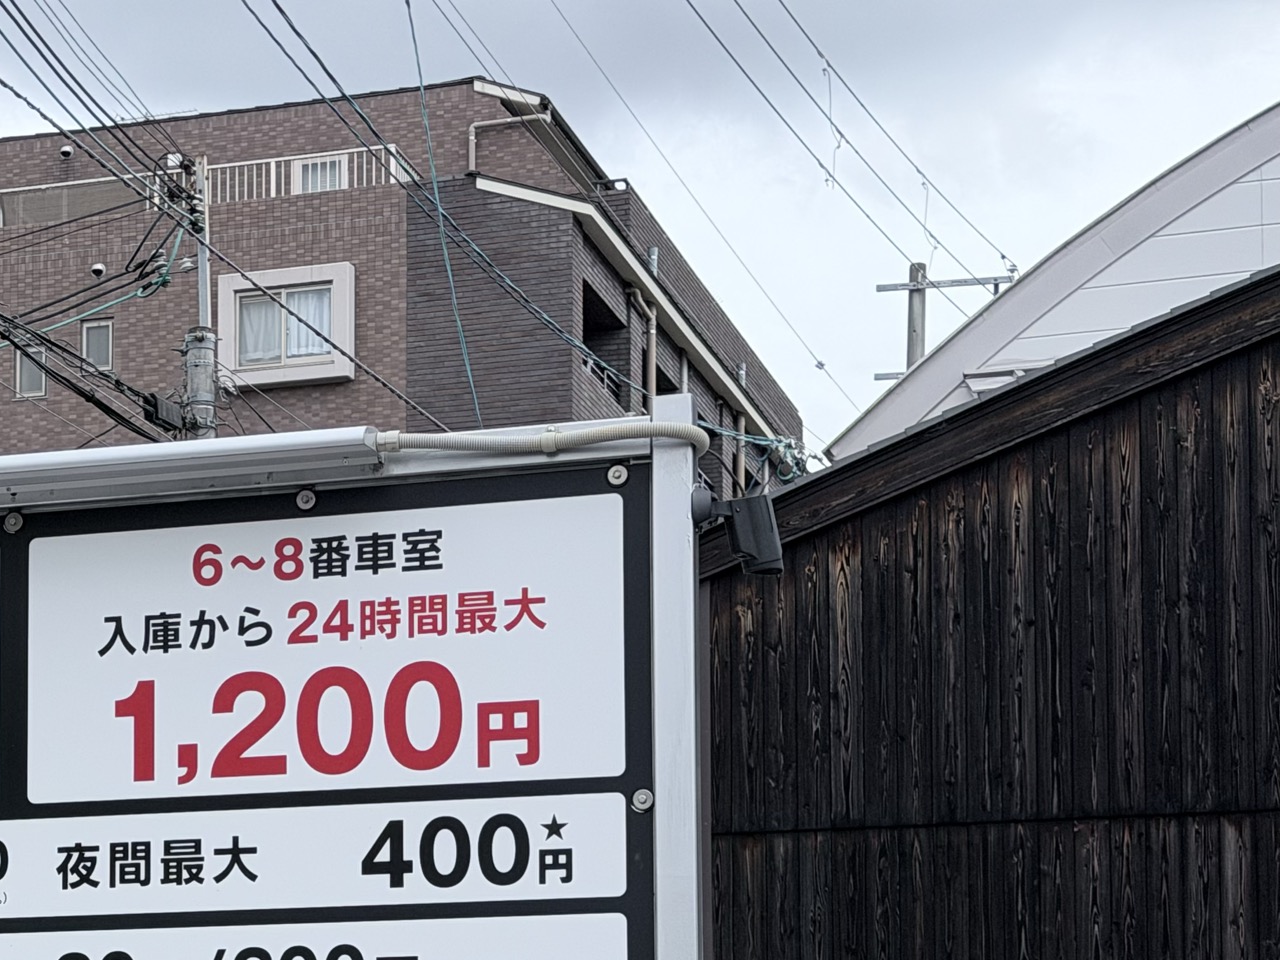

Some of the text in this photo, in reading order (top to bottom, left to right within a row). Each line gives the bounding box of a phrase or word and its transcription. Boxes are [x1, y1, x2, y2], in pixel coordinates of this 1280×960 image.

[114, 660, 541, 786] 1,200円
[56, 835, 259, 889] 夜間最大
